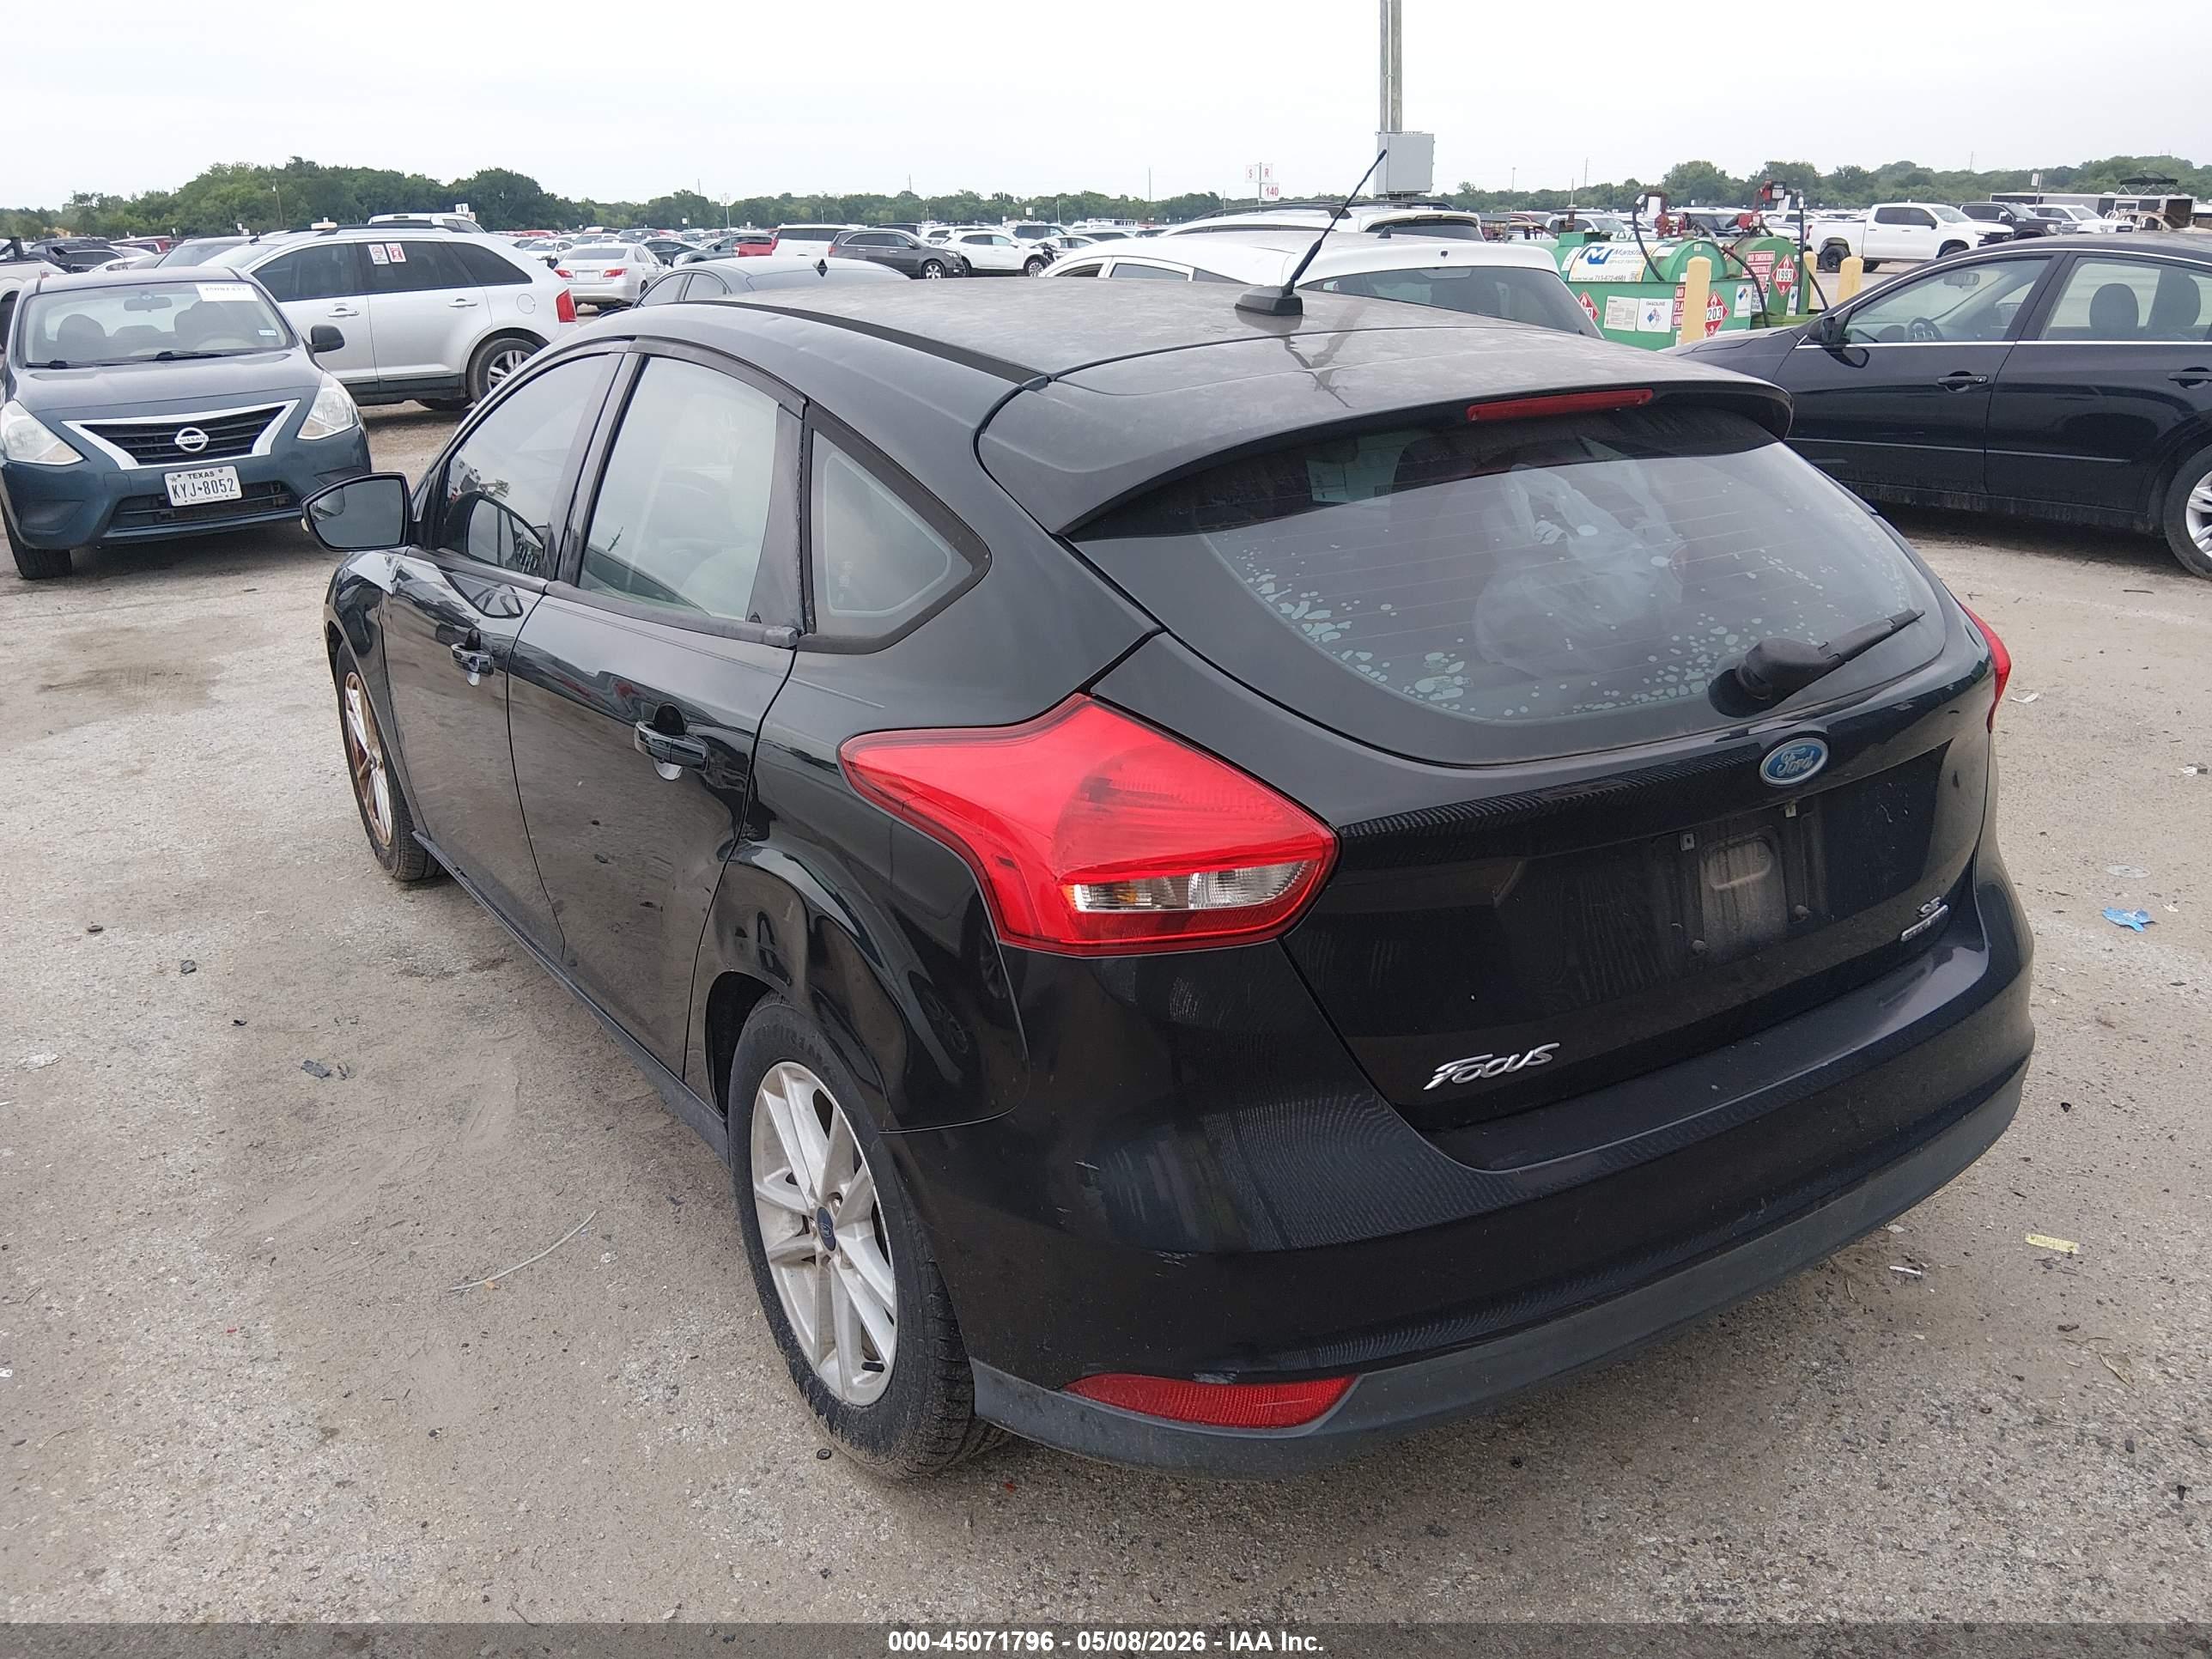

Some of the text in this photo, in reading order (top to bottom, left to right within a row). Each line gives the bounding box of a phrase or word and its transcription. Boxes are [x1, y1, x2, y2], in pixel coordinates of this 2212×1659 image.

[1265, 186, 1279, 197] 140
[1778, 270, 1792, 281] 1993
[1707, 307, 1722, 320] 203
[187, 471, 215, 480] TEXAS
[1777, 747, 1815, 777] Ford
